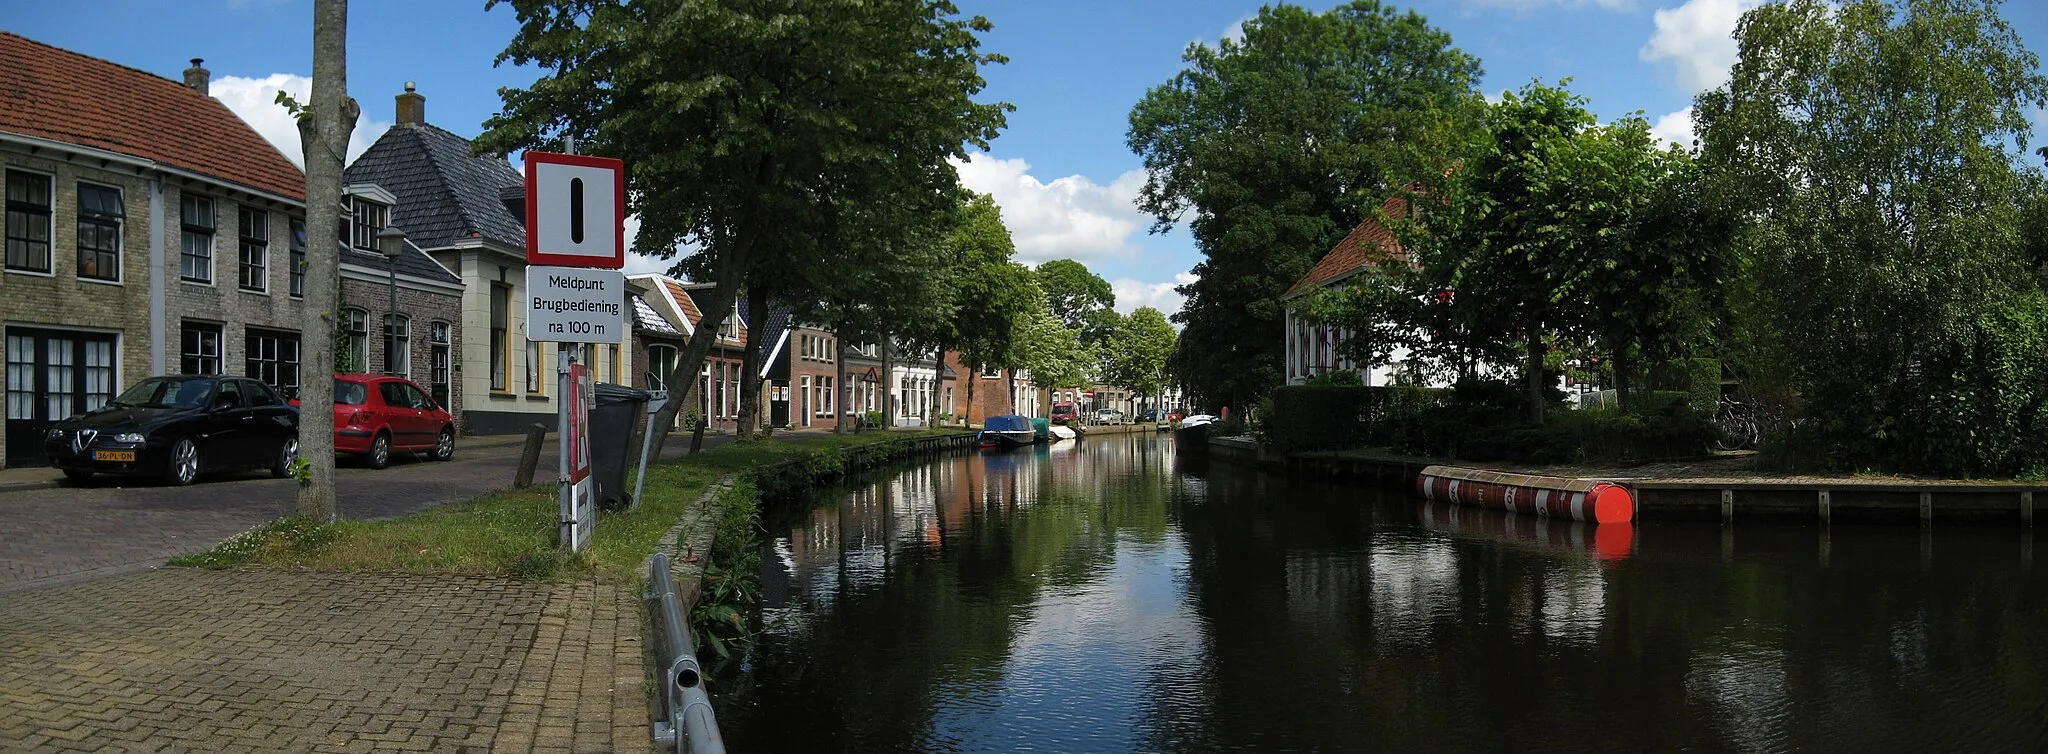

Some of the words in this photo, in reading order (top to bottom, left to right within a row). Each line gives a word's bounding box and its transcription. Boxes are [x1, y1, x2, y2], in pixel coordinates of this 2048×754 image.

[549, 275, 604, 291] Meldpunt
[534, 297, 618, 315] Brugbediening
[549, 322, 563, 333] na
[569, 321, 590, 333] 100
[595, 324, 604, 334] m
